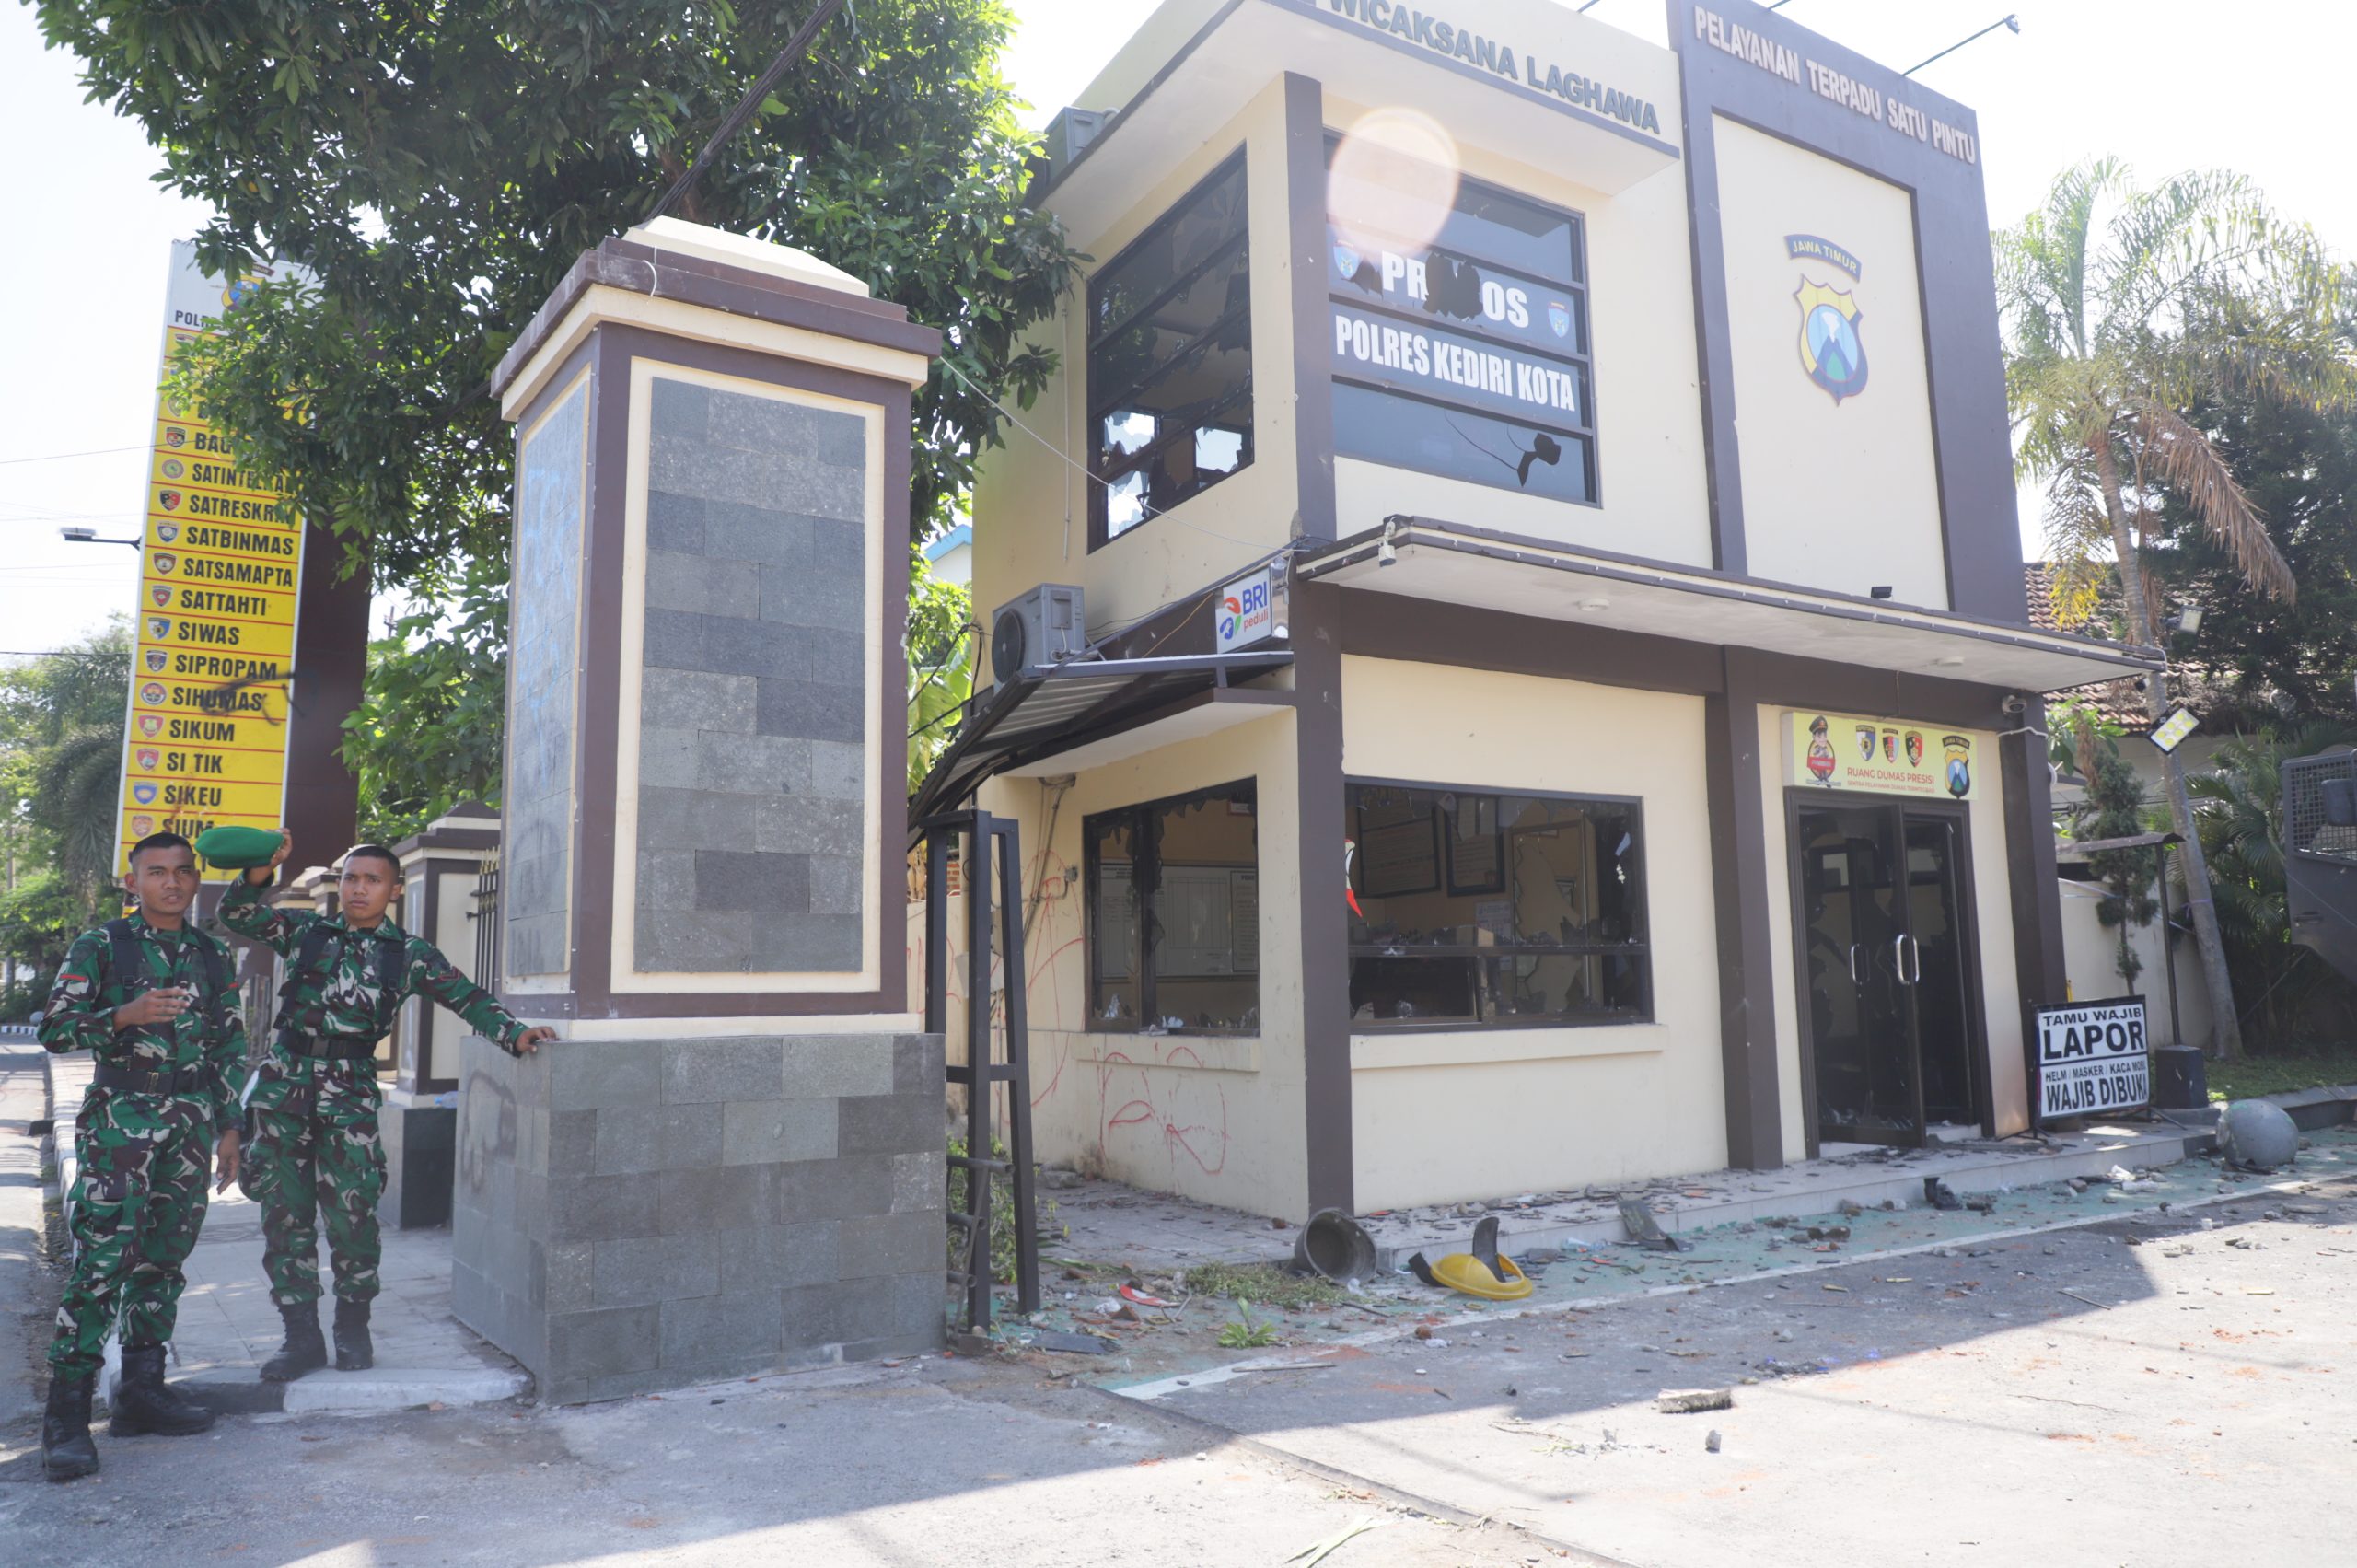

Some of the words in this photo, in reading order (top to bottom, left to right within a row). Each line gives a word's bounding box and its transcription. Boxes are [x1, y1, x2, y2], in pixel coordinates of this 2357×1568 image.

[1527, 55, 1660, 134] LAGHAWA
[1694, 5, 1800, 85] PELAYANAN
[1805, 58, 1882, 122] TERPADU
[1887, 97, 1927, 142] SATU
[1932, 118, 1976, 165] PINTU
[1793, 240, 1822, 255] JAWA
[1823, 244, 1858, 274] TIMUR
[1381, 250, 1529, 328] PROS
[1335, 315, 1430, 376] POLRES
[1434, 340, 1513, 397] KEDIRI
[1517, 362, 1576, 412] KOTA
[189, 494, 294, 524] SATRESKR
[187, 526, 294, 555] SATBINMAS
[184, 558, 293, 587] SATSAMAPTA
[180, 590, 266, 616] SATTAHTI
[1242, 581, 1267, 615] BRI
[178, 621, 240, 645] SIWAS
[1243, 608, 1269, 633] peduli
[175, 654, 277, 680] SIPROPAM
[172, 687, 262, 711] SIHUMAS
[169, 719, 235, 742] SIKUM
[167, 752, 186, 772] SI
[193, 753, 223, 774] TIK
[1847, 767, 1875, 779] RUANG
[1877, 770, 1906, 783] DUMAS
[1907, 772, 1935, 784] PRESISI
[164, 785, 222, 807] SIKEU
[2044, 1013, 2087, 1027] TAMU
[2093, 1007, 2142, 1021] WAJIB
[2044, 1021, 2144, 1060] LAPOR
[2046, 1070, 2067, 1083] HELM
[2073, 1065, 2104, 1079] MASKER
[2109, 1062, 2131, 1074] KACA
[2046, 1080, 2096, 1112] WAJIB
[2099, 1073, 2147, 1106] DIBUKA
